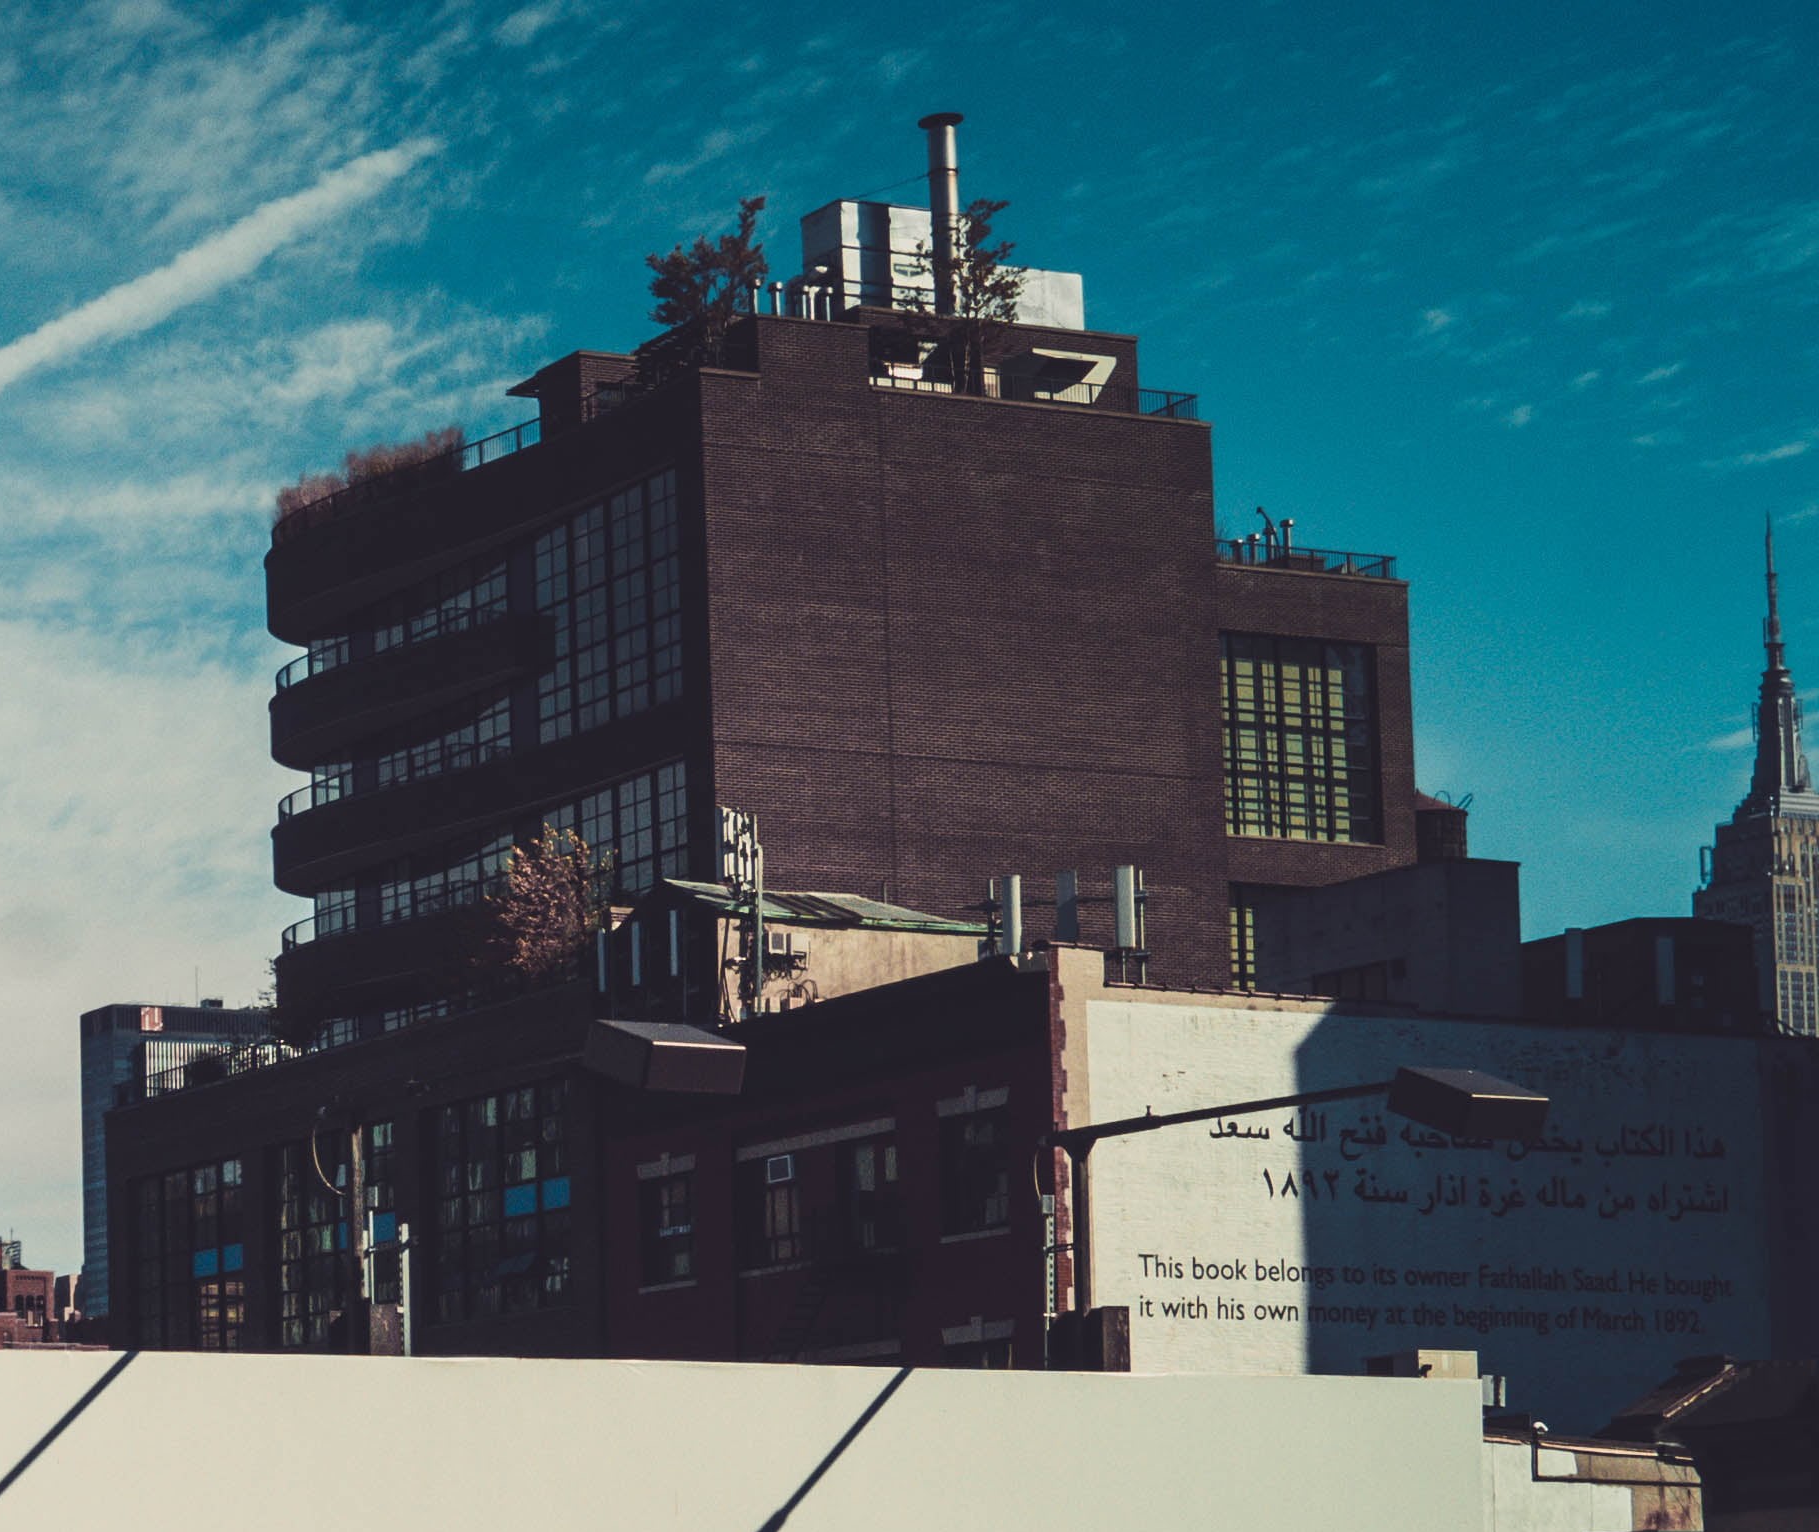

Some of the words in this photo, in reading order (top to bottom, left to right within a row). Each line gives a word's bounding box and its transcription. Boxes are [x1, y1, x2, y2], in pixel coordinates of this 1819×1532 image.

[1209, 1117, 1270, 1141] سعد
[1283, 1105, 1326, 1143] الله
[1339, 1115, 1387, 1161] فتح
[1684, 1125, 1727, 1159] هذا
[1595, 1122, 1674, 1167] الكتاب
[1354, 1168, 1409, 1204] سنة
[1478, 1177, 1526, 1217] غرة
[1536, 1175, 1587, 1210] ماله
[1598, 1185, 1636, 1219] من
[1647, 1180, 1729, 1222] اشتراه
[1138, 1253, 1183, 1280] This
[1191, 1256, 1248, 1281] book
[1255, 1258, 1335, 1289] belongs
[1342, 1266, 1365, 1285] to
[1373, 1264, 1396, 1285] its
[1404, 1271, 1472, 1288] owner
[1478, 1264, 1566, 1292] Fathallah
[1573, 1268, 1622, 1294] Saad.
[1628, 1270, 1659, 1296] He
[1664, 1272, 1733, 1303] bought
[1138, 1294, 1155, 1319] it
[1161, 1296, 1209, 1320] with
[1216, 1297, 1246, 1321] his
[1252, 1304, 1299, 1322] own
[1307, 1306, 1376, 1330] money
[1385, 1307, 1405, 1325] at
[1413, 1303, 1445, 1326] the
[1453, 1304, 1549, 1335] beginning
[1555, 1306, 1578, 1330] of
[1582, 1307, 1646, 1333] March
[1653, 1309, 1703, 1335] 1892.
